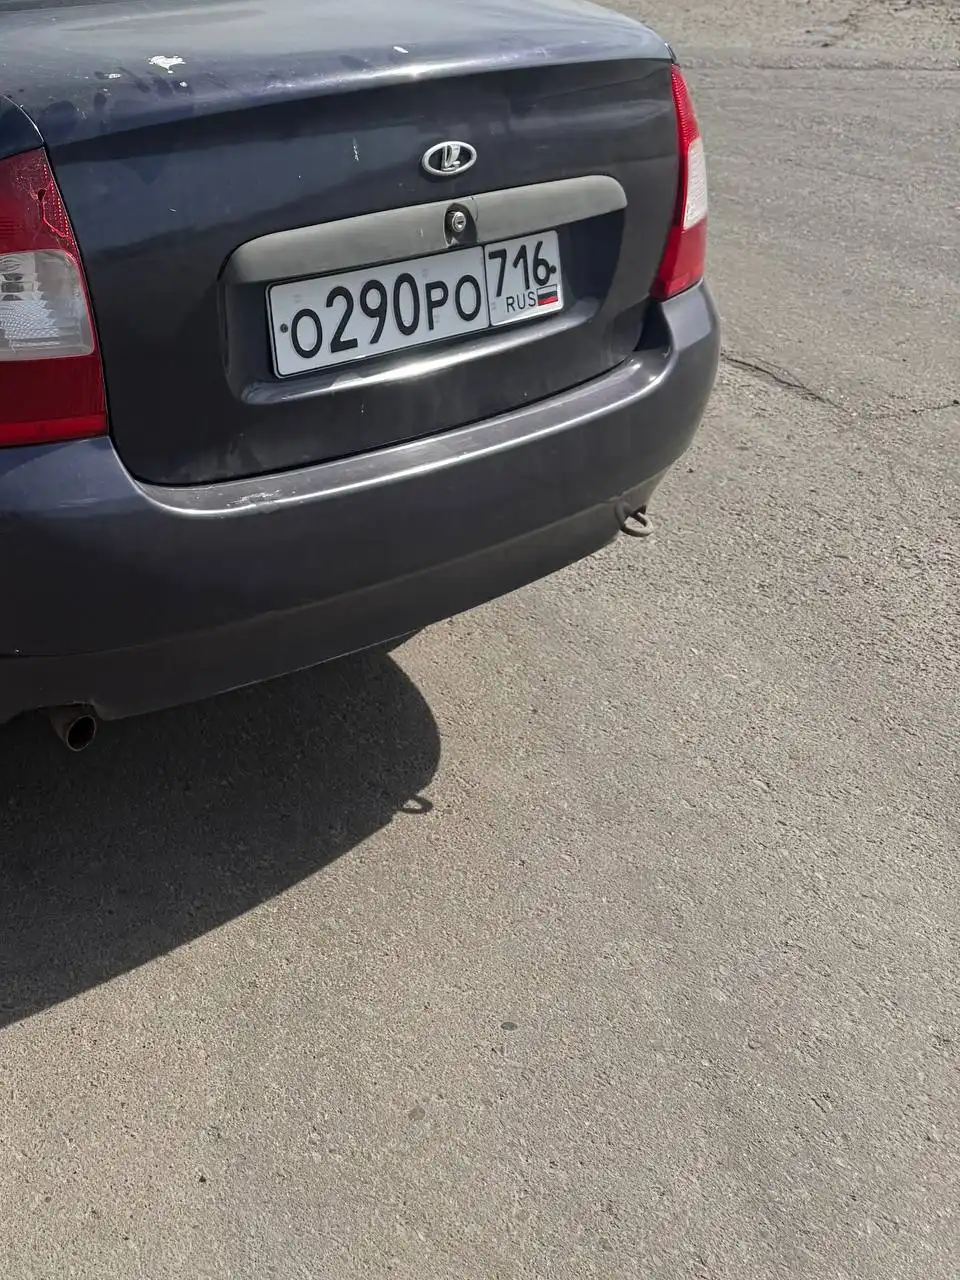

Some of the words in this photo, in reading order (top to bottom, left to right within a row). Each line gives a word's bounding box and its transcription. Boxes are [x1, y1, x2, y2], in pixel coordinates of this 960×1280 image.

[291, 273, 482, 359] О290РО
[488, 241, 552, 297] 716
[506, 290, 537, 314] RUS
